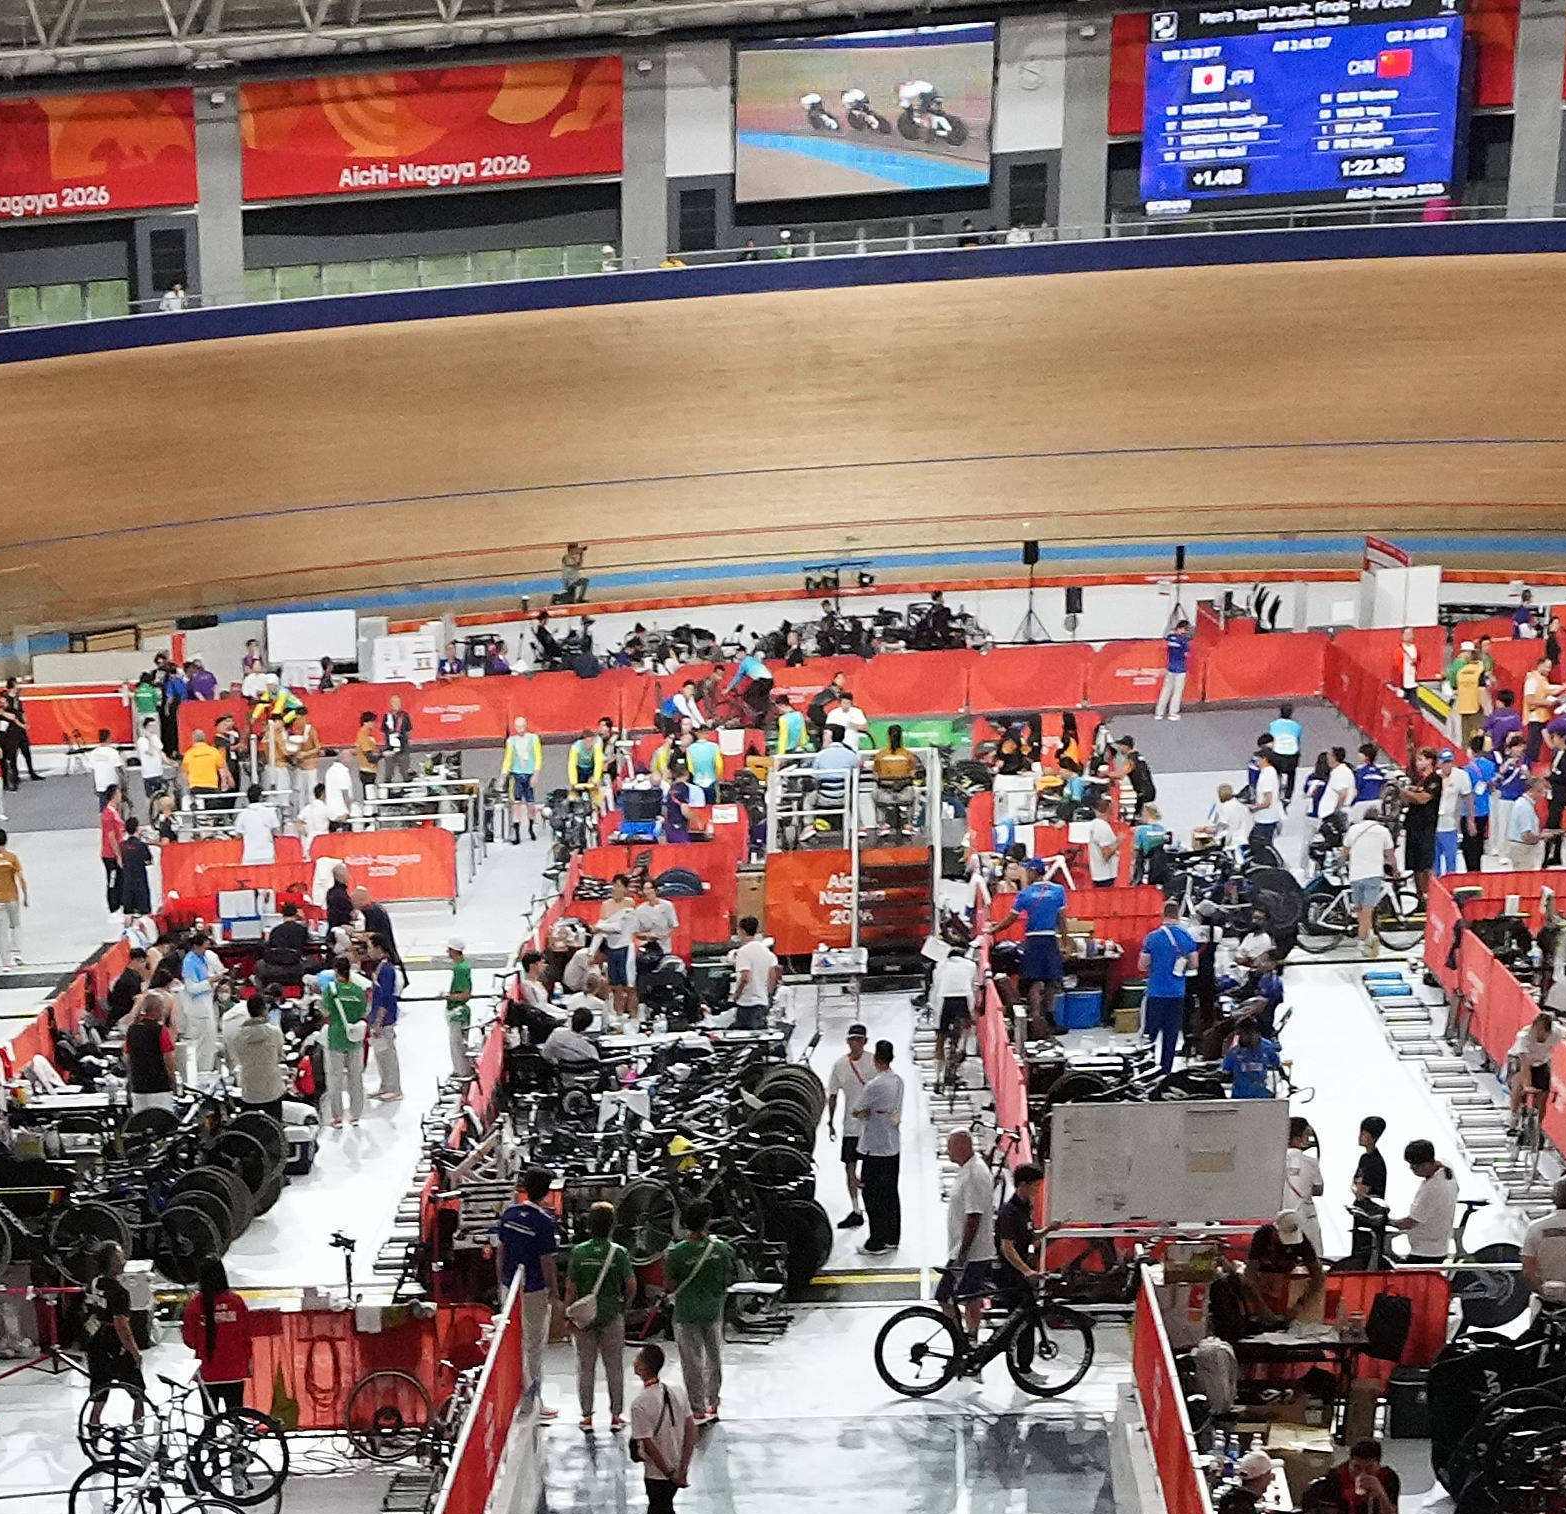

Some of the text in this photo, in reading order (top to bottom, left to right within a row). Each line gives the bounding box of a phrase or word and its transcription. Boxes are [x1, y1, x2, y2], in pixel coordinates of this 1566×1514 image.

[339, 155, 532, 188] Aichi-Nagoya 2026
[61, 185, 110, 207] 2026
